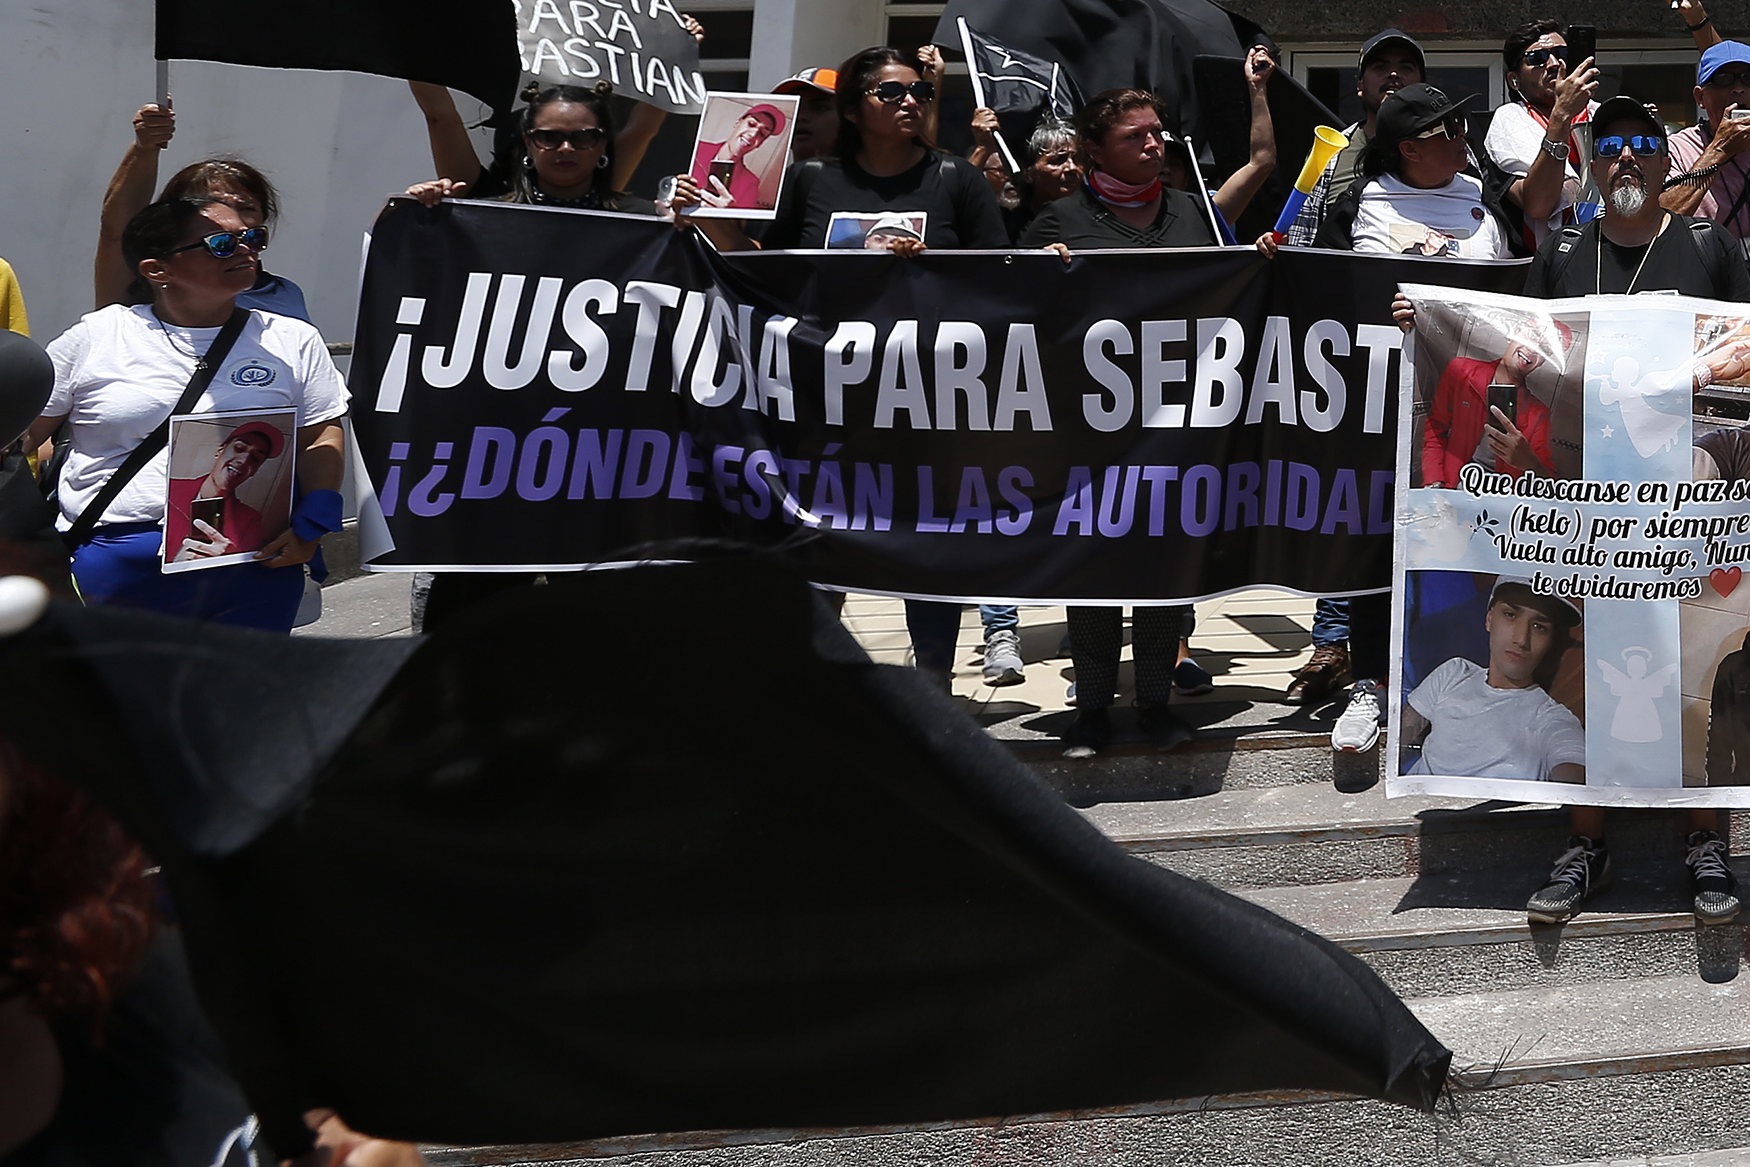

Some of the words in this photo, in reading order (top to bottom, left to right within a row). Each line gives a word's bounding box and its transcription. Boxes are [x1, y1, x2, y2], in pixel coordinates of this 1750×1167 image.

[375, 272, 798, 422] ¡JUSTICIA
[824, 319, 1053, 431] PARA
[1082, 315, 1404, 434] SEBAST
[380, 407, 704, 518] ¡¿DÓNDE
[713, 442, 893, 532] ESTÁN
[916, 465, 1034, 536] LAS
[1052, 459, 1394, 538] AUTORIDAD
[1462, 465, 1512, 497] Que
[1516, 472, 1631, 502] descanse
[1637, 482, 1668, 503] en
[1673, 482, 1729, 511] paz
[1511, 504, 1582, 544] (kelo)
[1589, 518, 1638, 545] por
[1493, 534, 1557, 564] Vuela
[1562, 543, 1609, 567] alto
[1614, 545, 1697, 575] amigo,
[1529, 571, 1553, 593] te
[1557, 573, 1702, 600] olvidaremos
